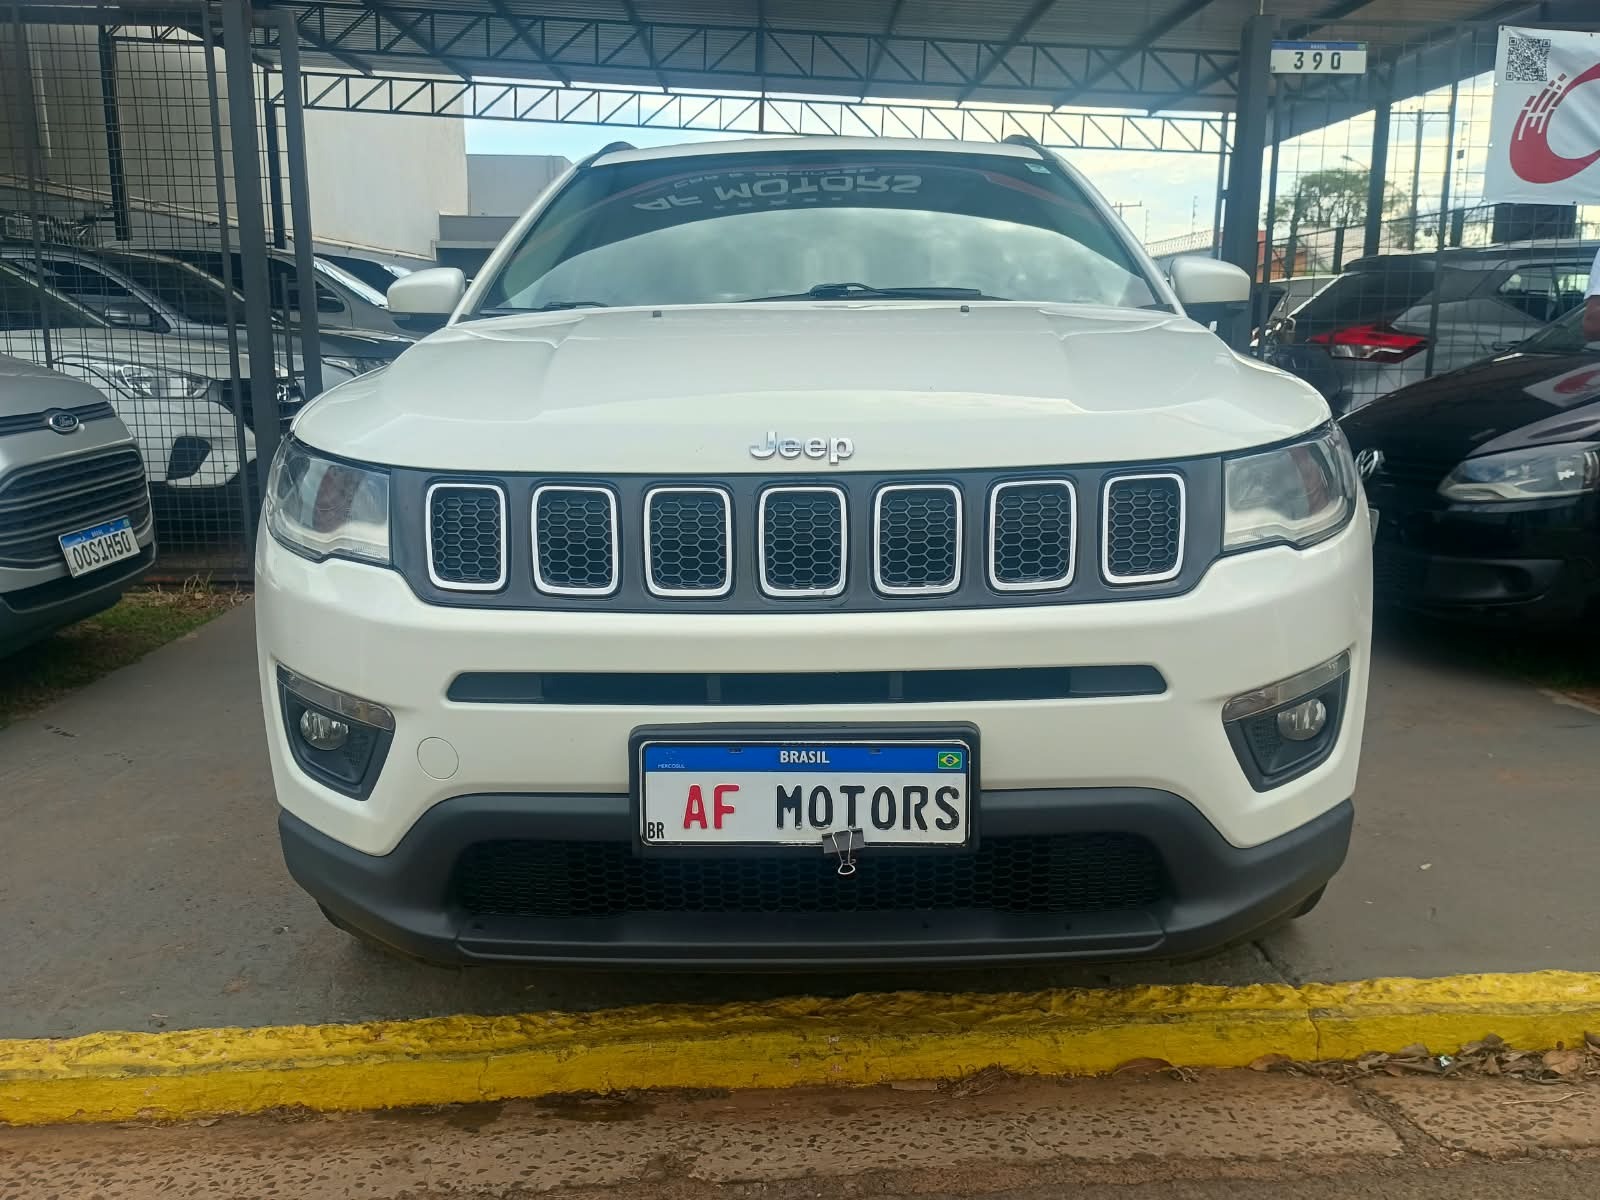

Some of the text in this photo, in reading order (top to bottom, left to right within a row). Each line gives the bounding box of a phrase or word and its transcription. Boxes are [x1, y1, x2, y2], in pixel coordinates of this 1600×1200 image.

[1294, 51, 1341, 70] 390
[750, 431, 854, 465] Jeep
[779, 750, 830, 764] BRASIL
[683, 784, 960, 831] AF MOTORS
[647, 821, 665, 840] BR
